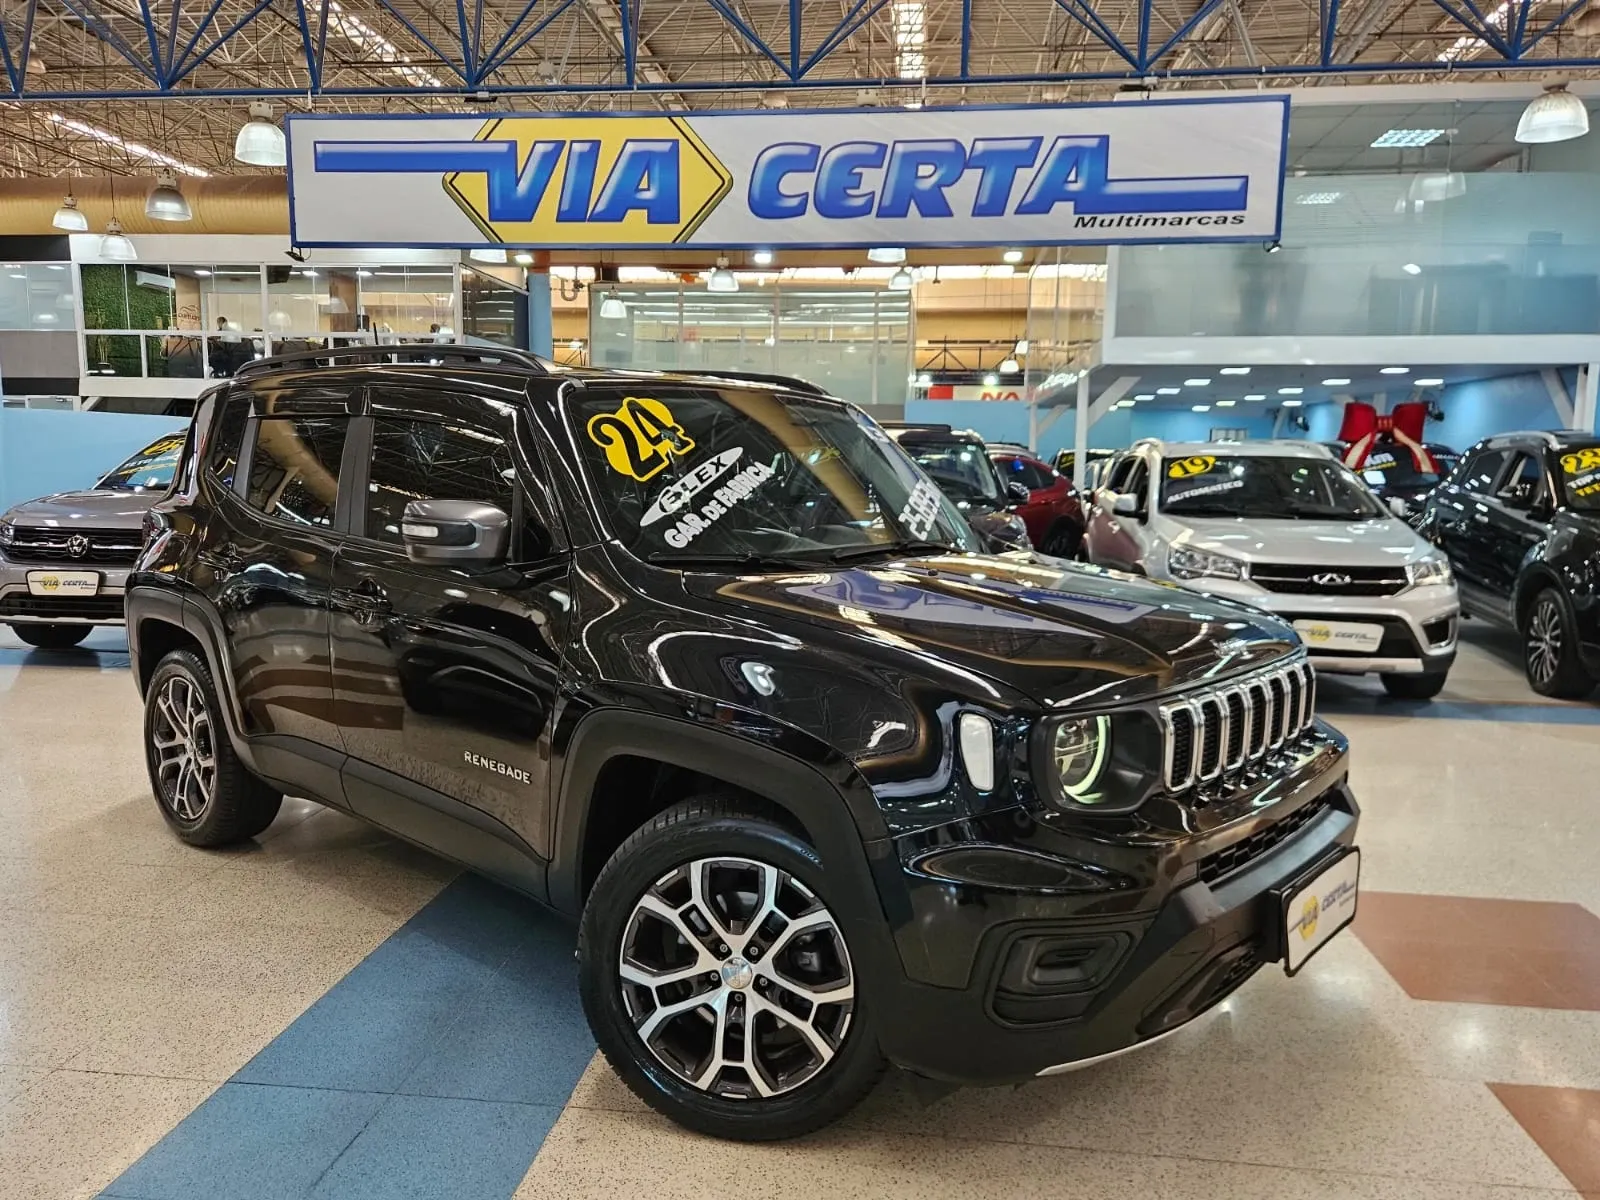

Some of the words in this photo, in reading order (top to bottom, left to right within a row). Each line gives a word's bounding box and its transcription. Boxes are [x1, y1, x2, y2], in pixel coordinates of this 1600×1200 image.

[487, 138, 681, 224] VIA
[747, 134, 1110, 220] CERTA
[1074, 213, 1247, 230] Multimarcas
[587, 397, 696, 482] 24
[713, 461, 775, 507] FABRICA
[701, 500, 727, 520] DE
[464, 751, 531, 784] RENEGADE
